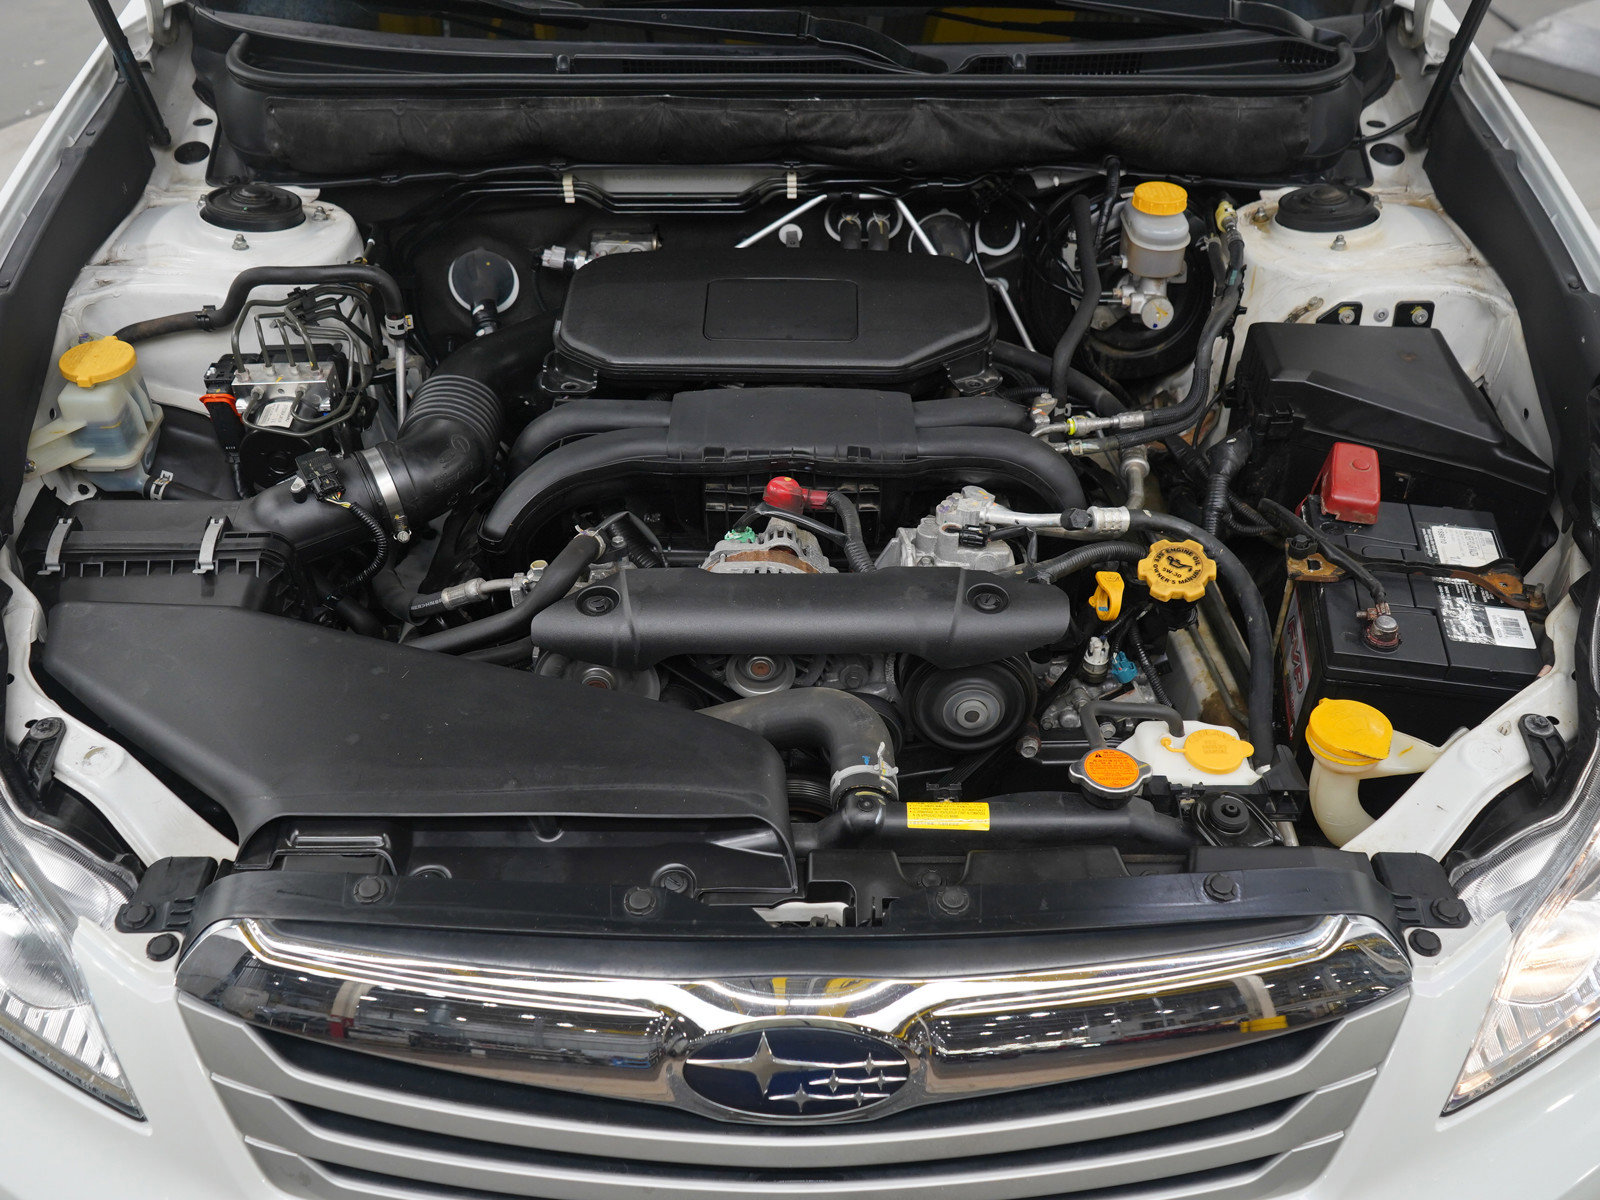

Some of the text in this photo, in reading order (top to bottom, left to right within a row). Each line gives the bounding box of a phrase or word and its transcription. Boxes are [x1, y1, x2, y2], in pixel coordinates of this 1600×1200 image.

[1166, 547, 1201, 566] ENGINE OIL
[1153, 563, 1176, 584] OWNER'S
[1178, 569, 1201, 584] MANUAL
[1162, 567, 1182, 579] 5W-30
